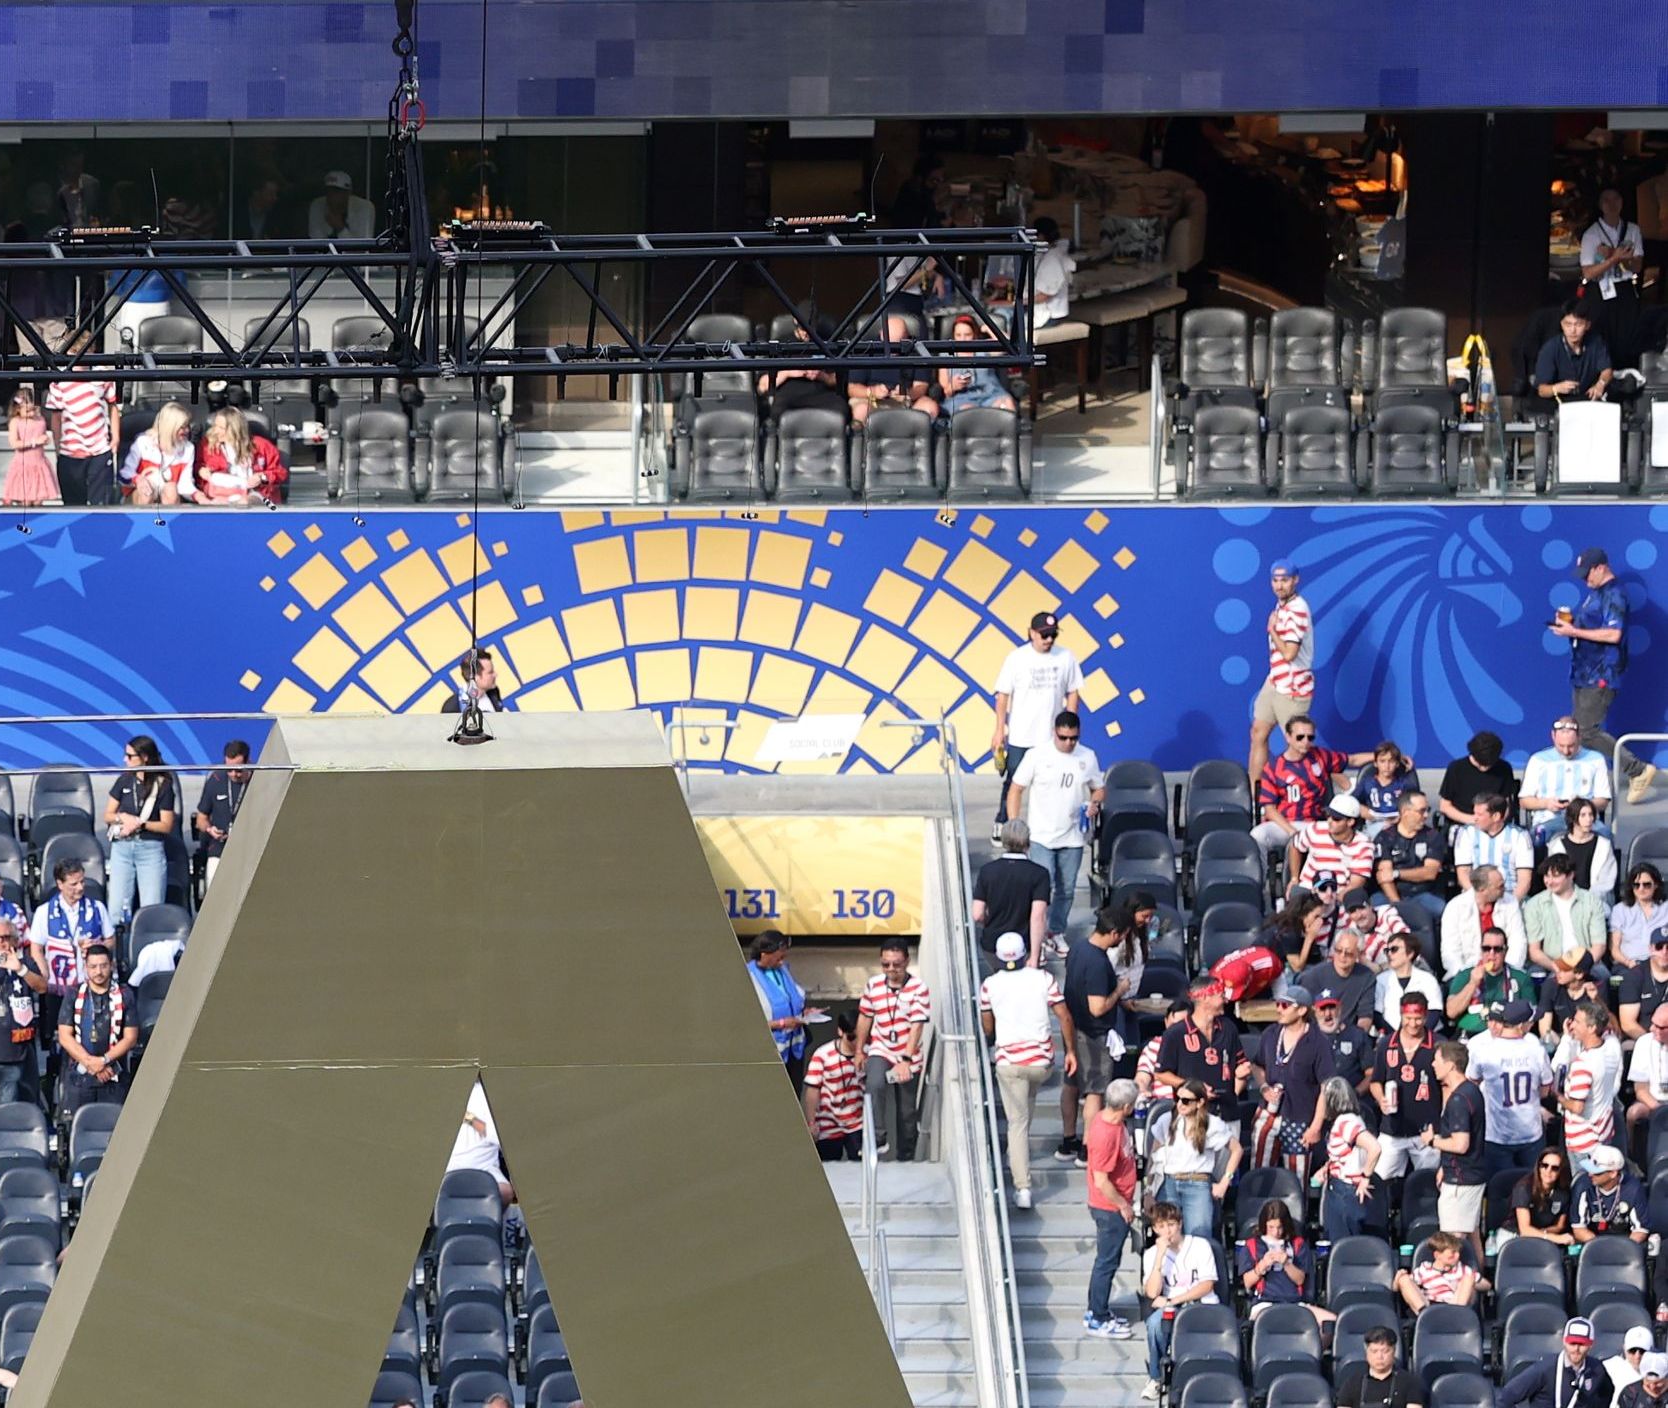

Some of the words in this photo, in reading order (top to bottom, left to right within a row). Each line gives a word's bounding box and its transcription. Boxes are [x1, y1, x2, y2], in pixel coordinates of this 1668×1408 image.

[1061, 773, 1074, 789] 10
[1287, 785, 1301, 803] 10
[726, 888, 781, 920] 131
[832, 887, 895, 918] 130
[1499, 1072, 1532, 1107] 10
